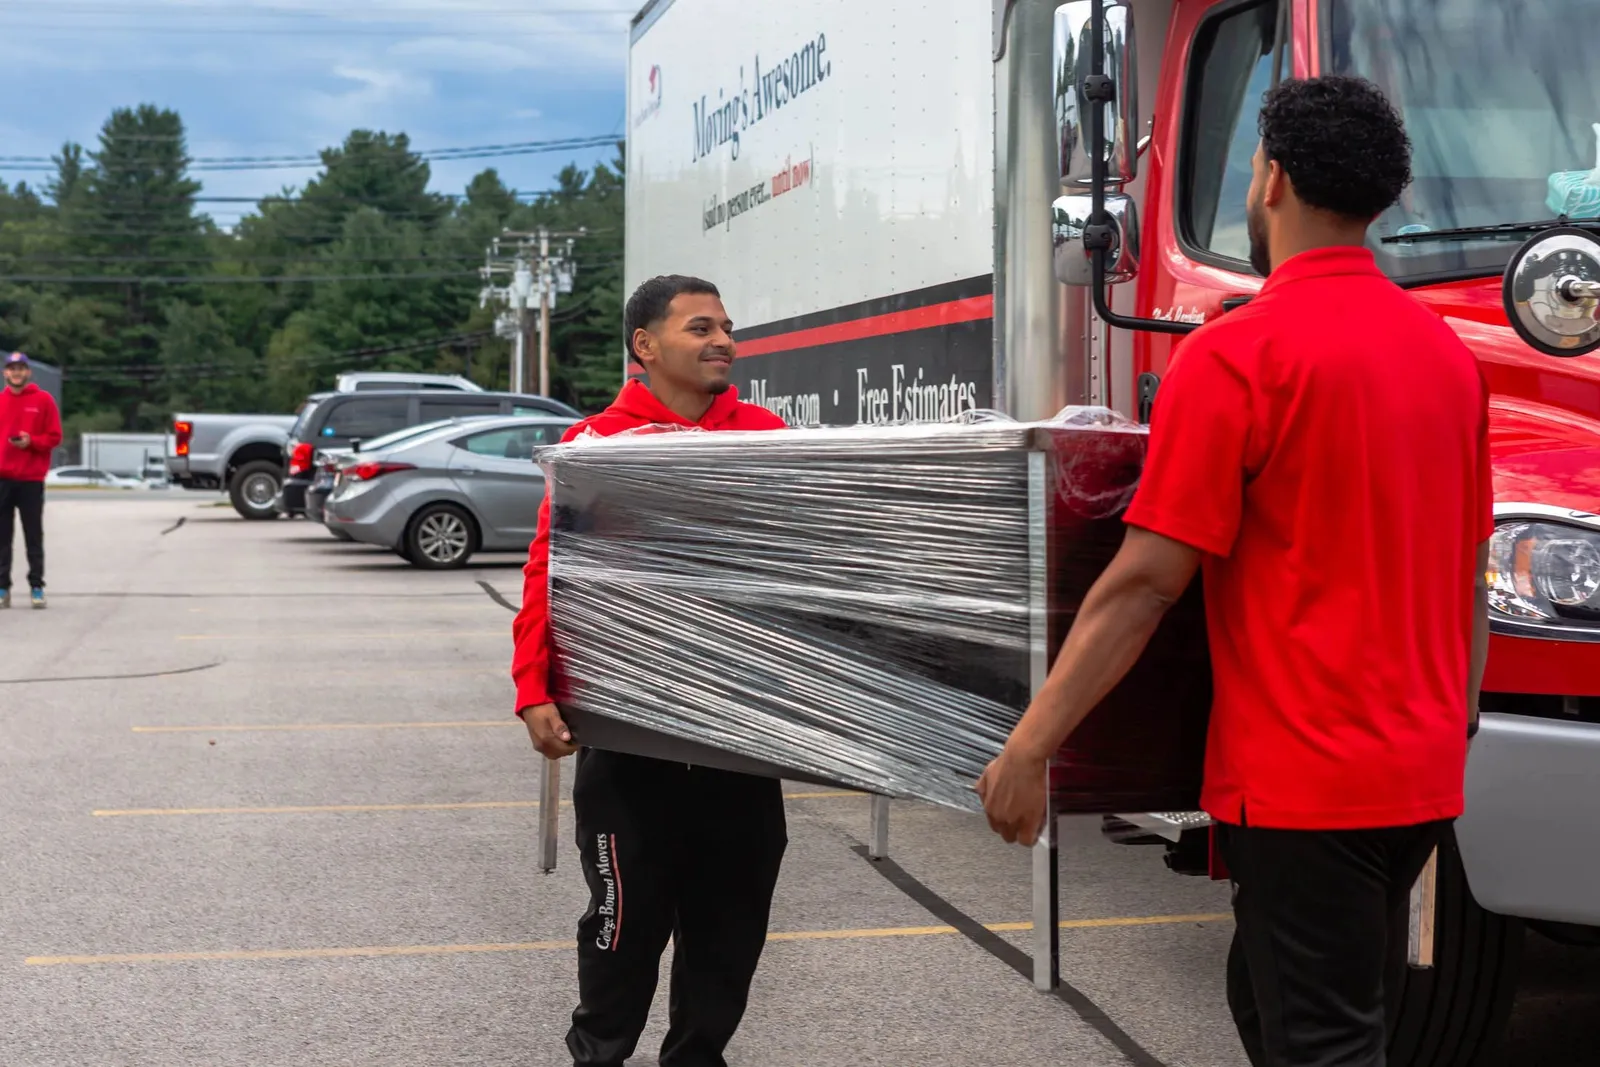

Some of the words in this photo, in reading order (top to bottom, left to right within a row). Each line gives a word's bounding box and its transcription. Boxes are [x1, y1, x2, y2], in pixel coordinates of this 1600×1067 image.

[693, 64, 748, 163] Moving's
[750, 32, 831, 125] Awesome.
[717, 202, 726, 225] no
[727, 190, 749, 232] person
[772, 153, 791, 198] until
[856, 367, 889, 424] Free
[891, 364, 976, 424] Estimates
[595, 833, 612, 876] Movers
[599, 878, 615, 916] Bound
